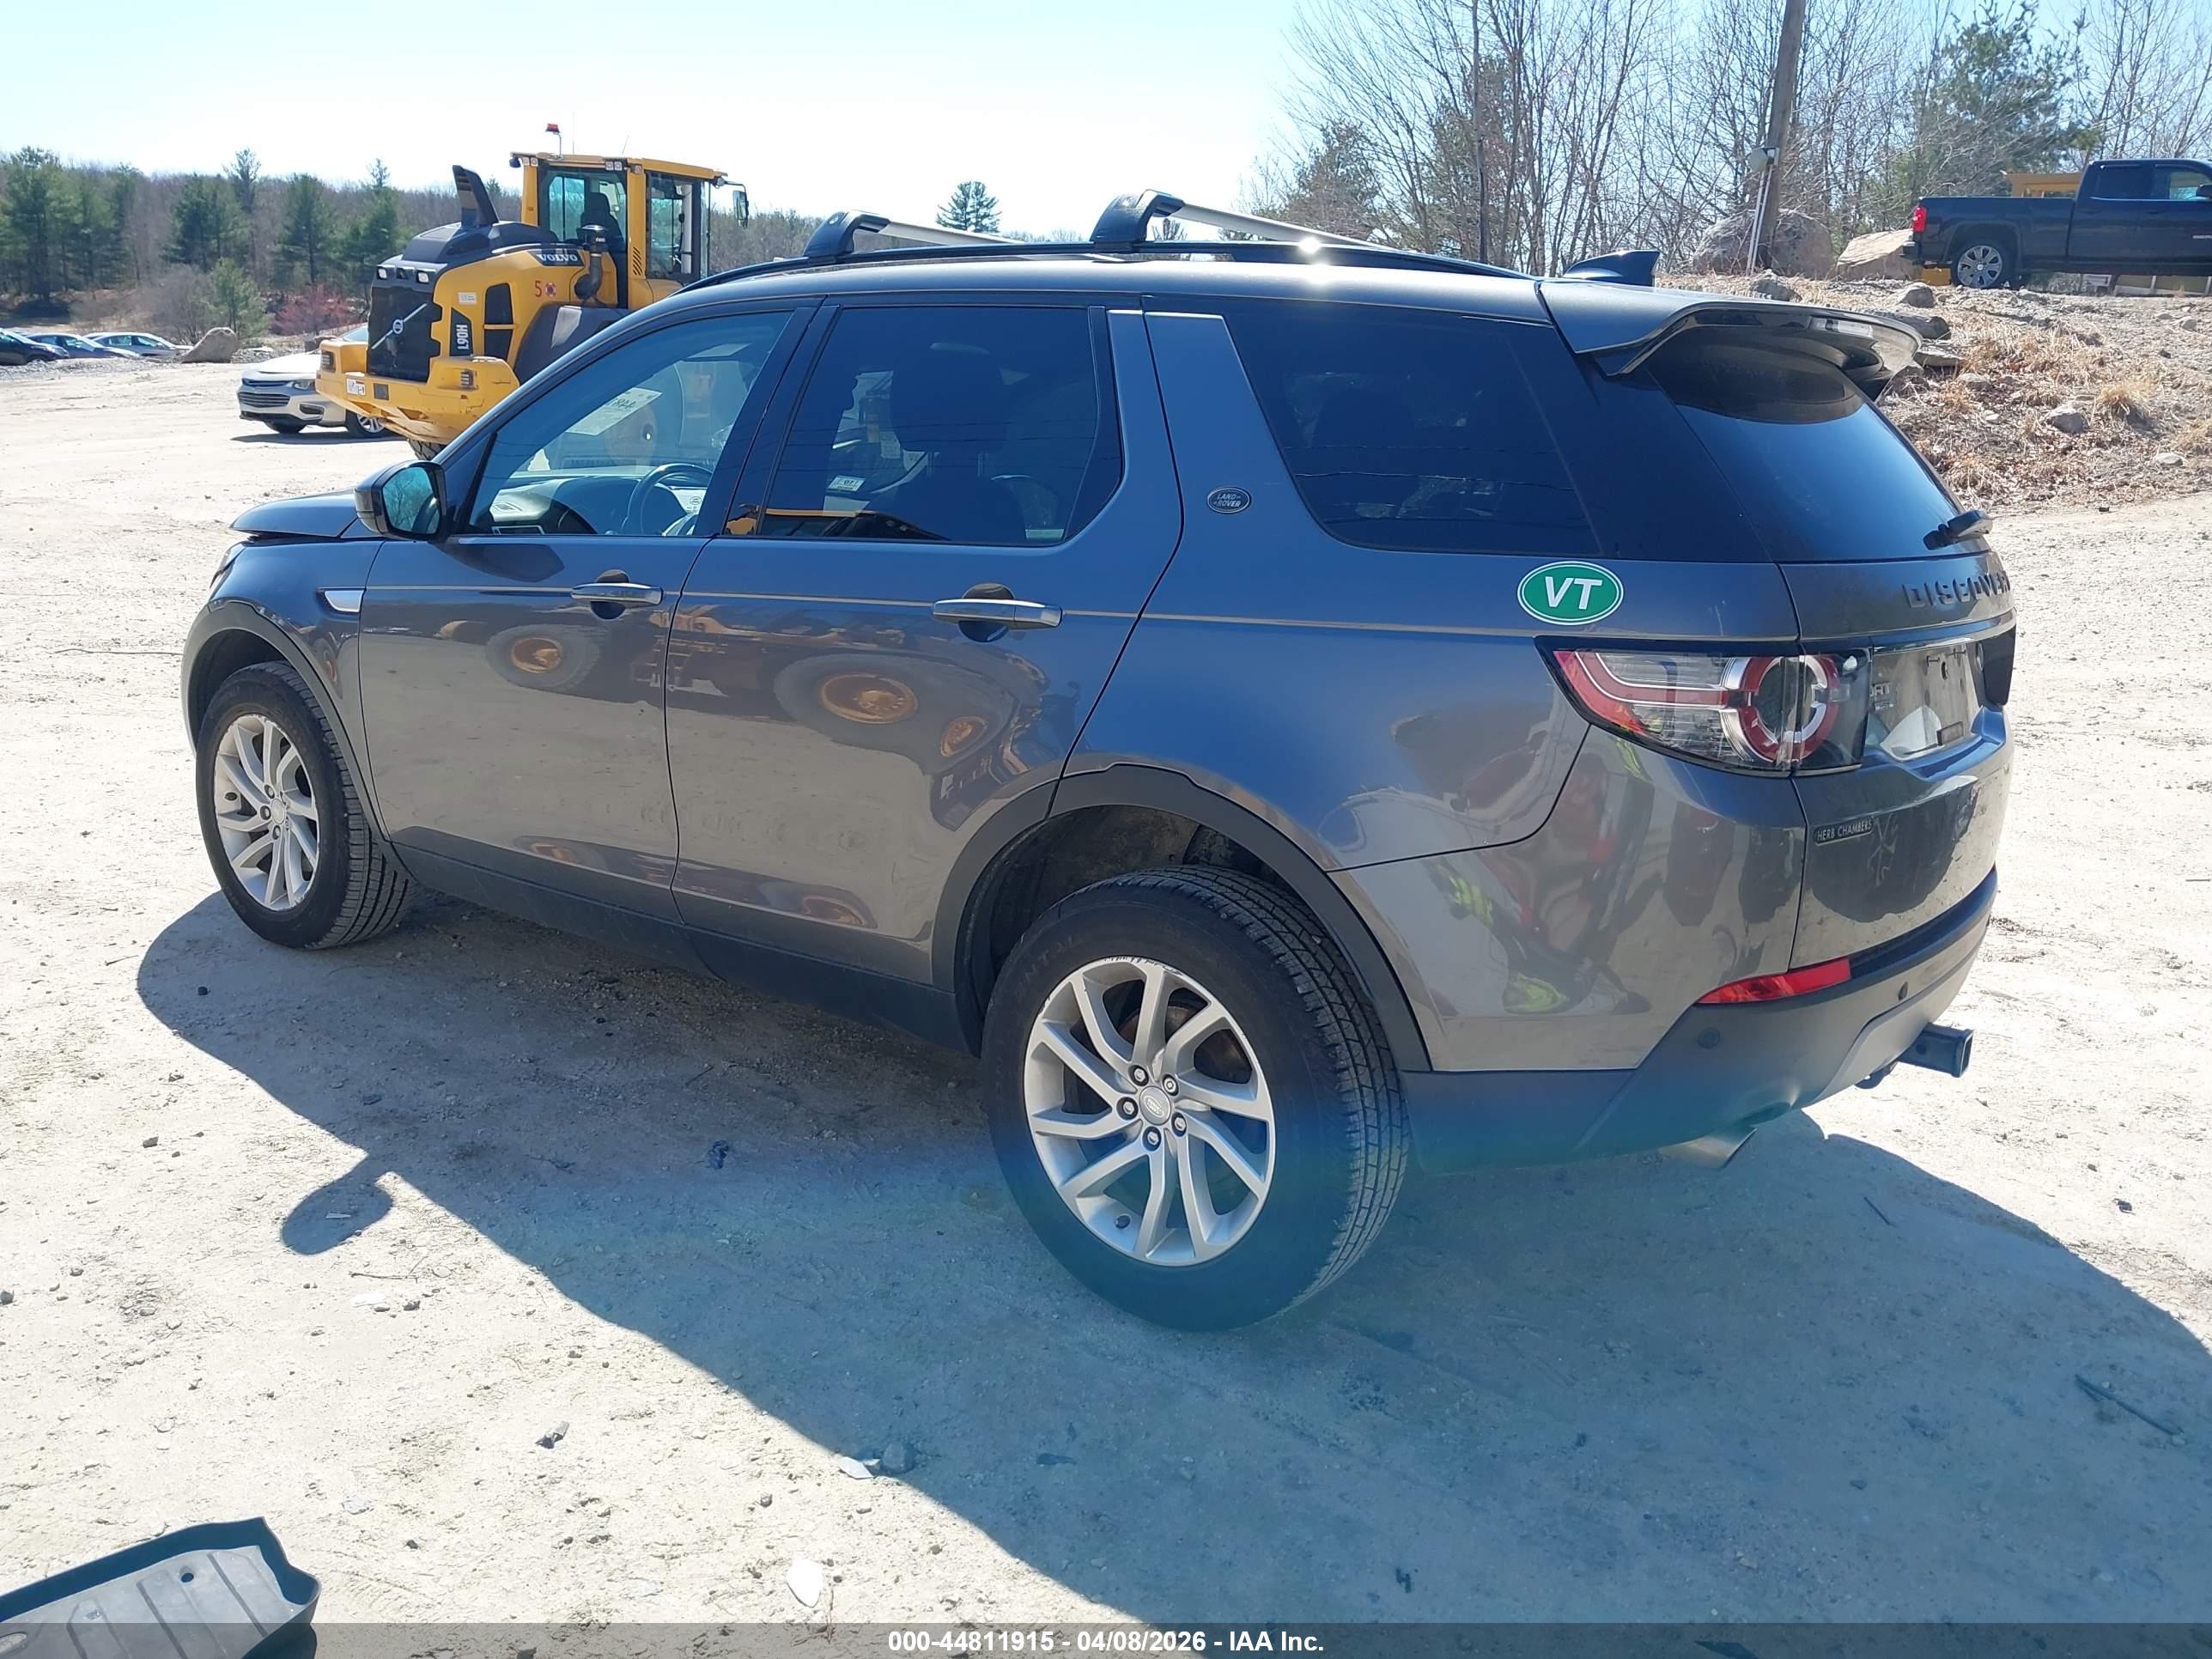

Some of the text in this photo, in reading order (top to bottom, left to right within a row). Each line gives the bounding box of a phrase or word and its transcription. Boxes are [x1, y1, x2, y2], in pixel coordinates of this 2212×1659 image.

[537, 253, 579, 262] VOLVO
[535, 280, 543, 298] 5
[456, 324, 470, 350] L90H
[1544, 575, 1603, 611] VT
[1901, 570, 2011, 608] DISCOVER
[1817, 818, 1873, 842] HERB CHAMBERS
